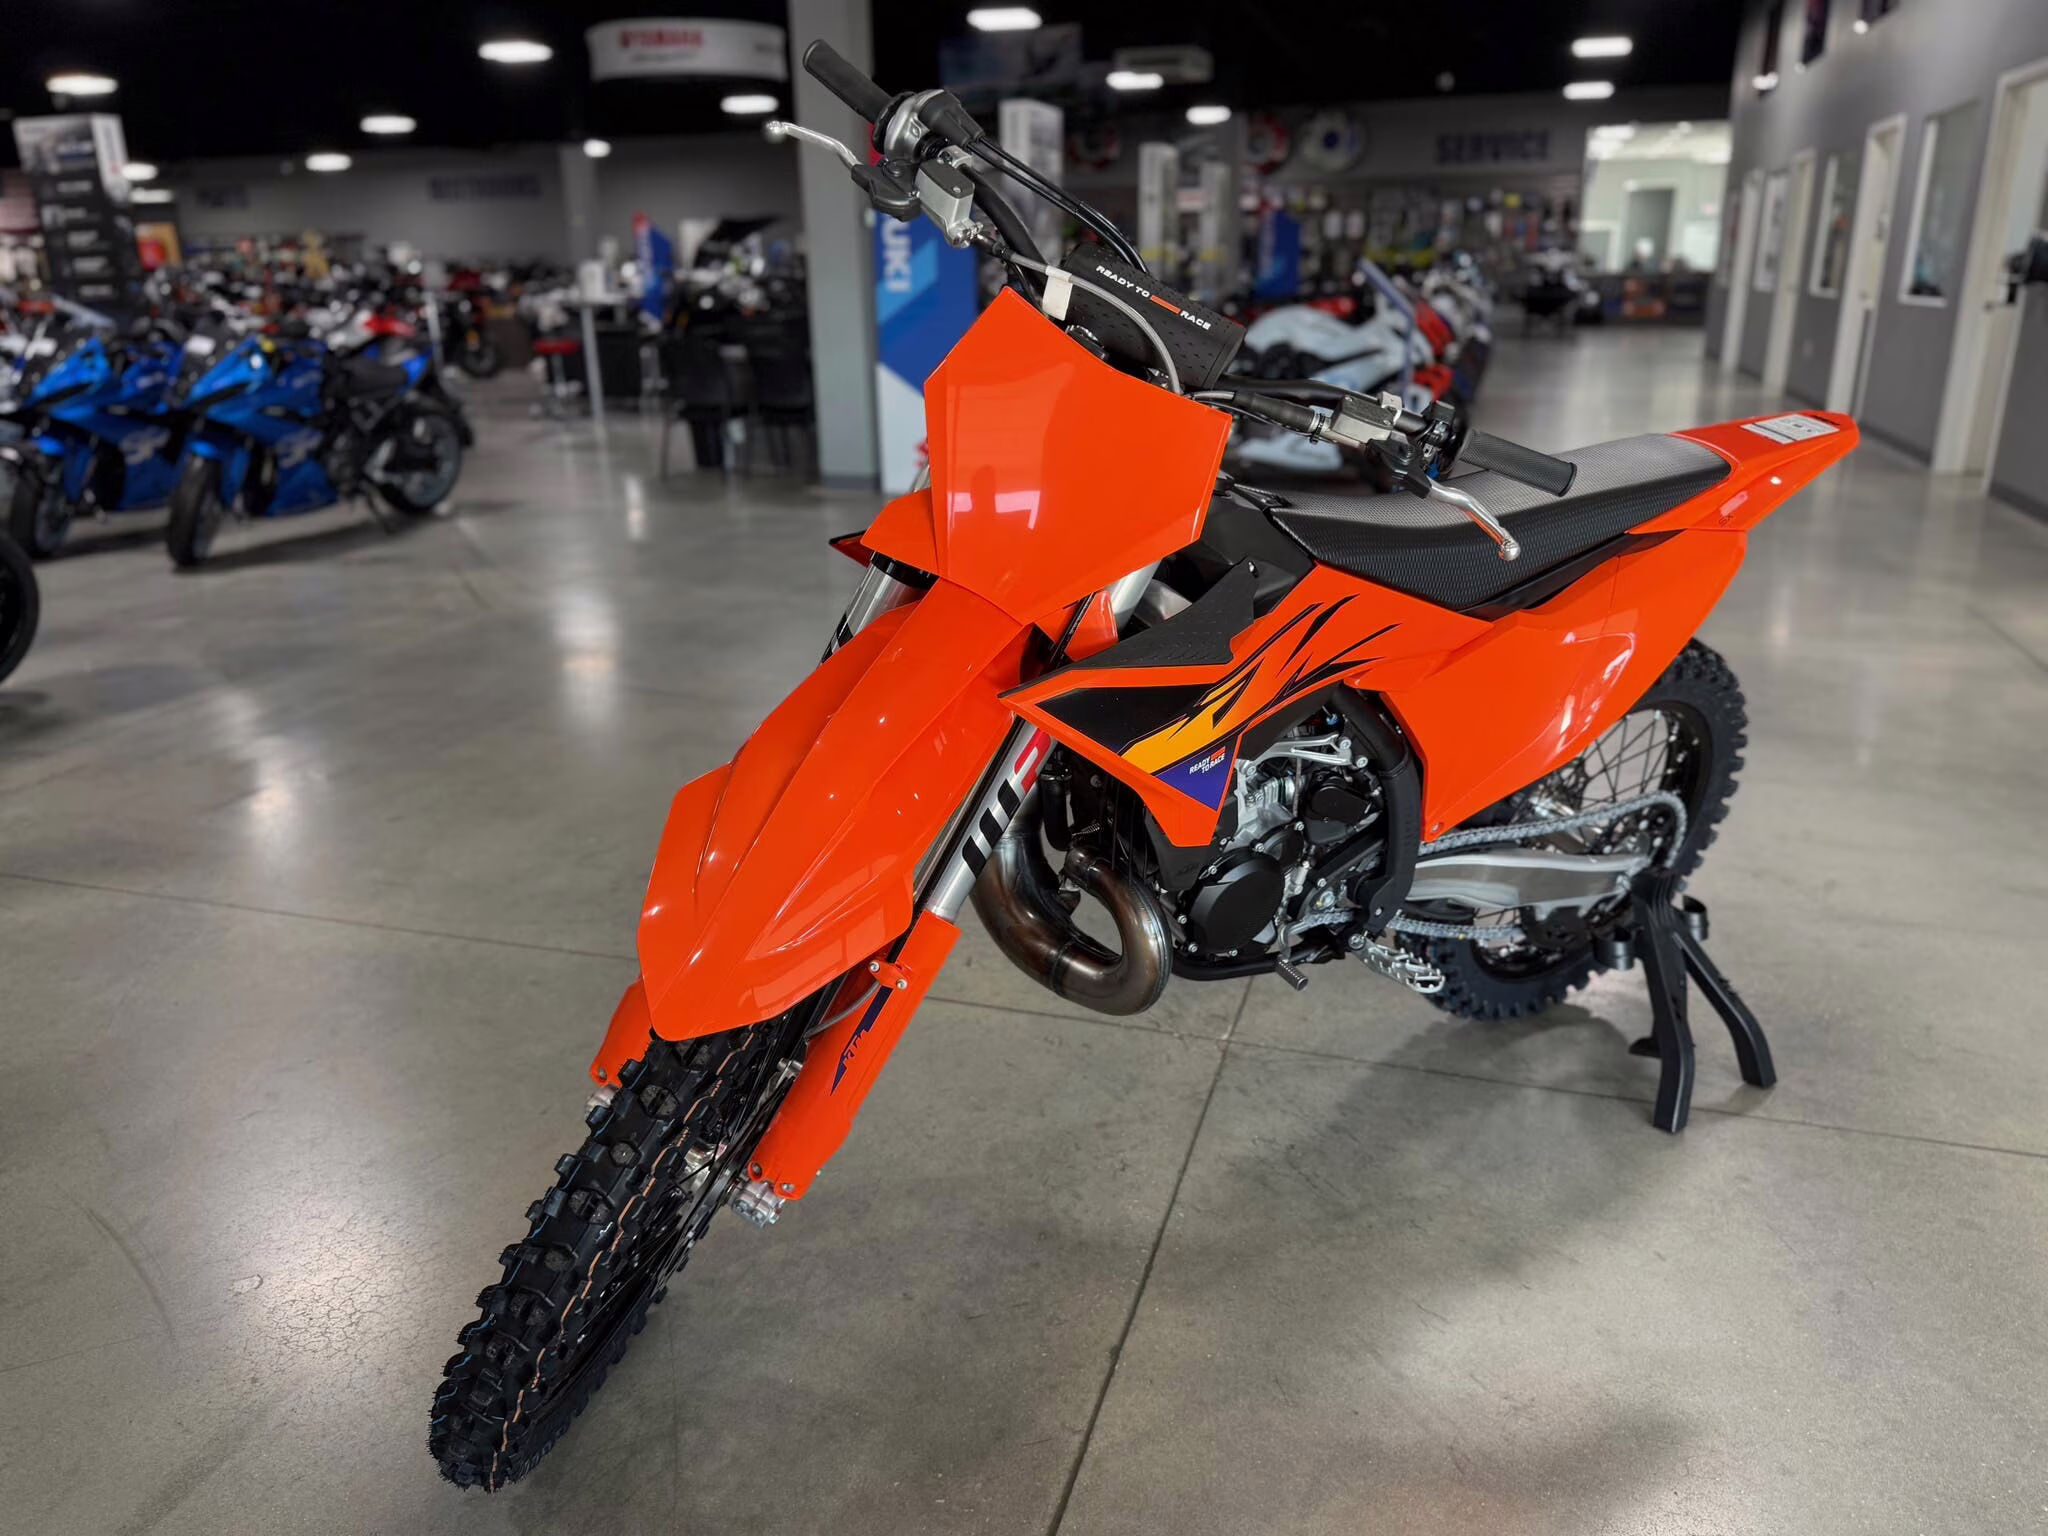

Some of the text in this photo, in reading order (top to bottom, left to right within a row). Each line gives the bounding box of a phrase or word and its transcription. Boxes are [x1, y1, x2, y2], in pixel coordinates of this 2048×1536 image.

[1095, 265, 1212, 330] READY TO RACE
[1189, 756, 1211, 775] READY
[1201, 753, 1226, 773] TO RACE
